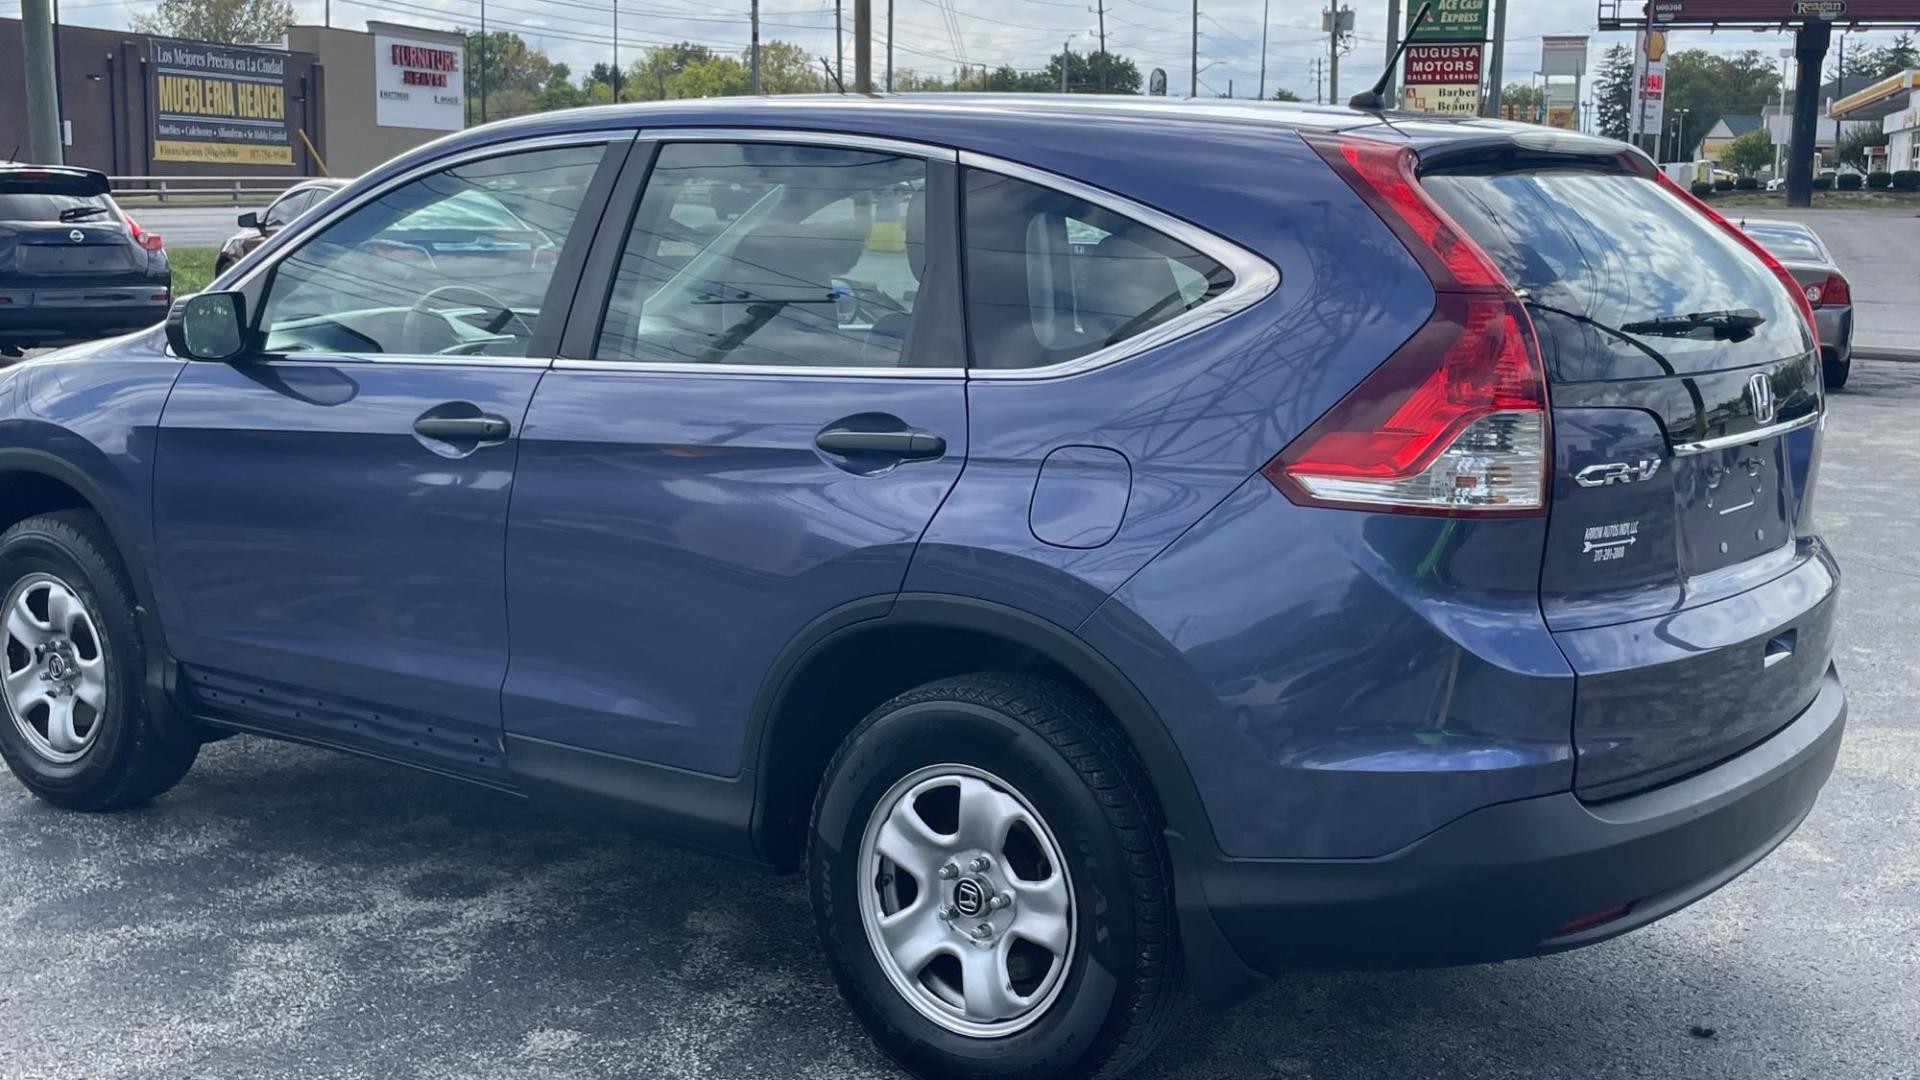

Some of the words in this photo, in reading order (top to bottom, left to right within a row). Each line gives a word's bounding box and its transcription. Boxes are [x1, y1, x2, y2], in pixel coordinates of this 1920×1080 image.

[1438, 0, 1458, 10] ACE
[1460, 0, 1483, 9] CASH
[1797, 1, 1841, 14] Reagan
[1441, 12, 1479, 23] EXPRESS
[392, 44, 459, 72] FURNITURE
[1409, 48, 1479, 58] AUGUSTA
[157, 46, 172, 62] Los
[174, 48, 205, 67] Mejores
[207, 51, 235, 70] Precios
[236, 59, 246, 71] en
[247, 57, 256, 72] La
[257, 58, 283, 75] Ciudad
[1413, 61, 1474, 72] MOTORS
[404, 70, 447, 88] HEAVEN
[159, 75, 235, 116] MUEBLERIA
[237, 82, 284, 119] HEAVEN
[1439, 88, 1476, 97] Barber
[1438, 102, 1475, 112] Beauty
[1575, 459, 1661, 488] CR-V
[1584, 527, 1603, 540] ARROW
[1603, 524, 1619, 538] AUTOS
